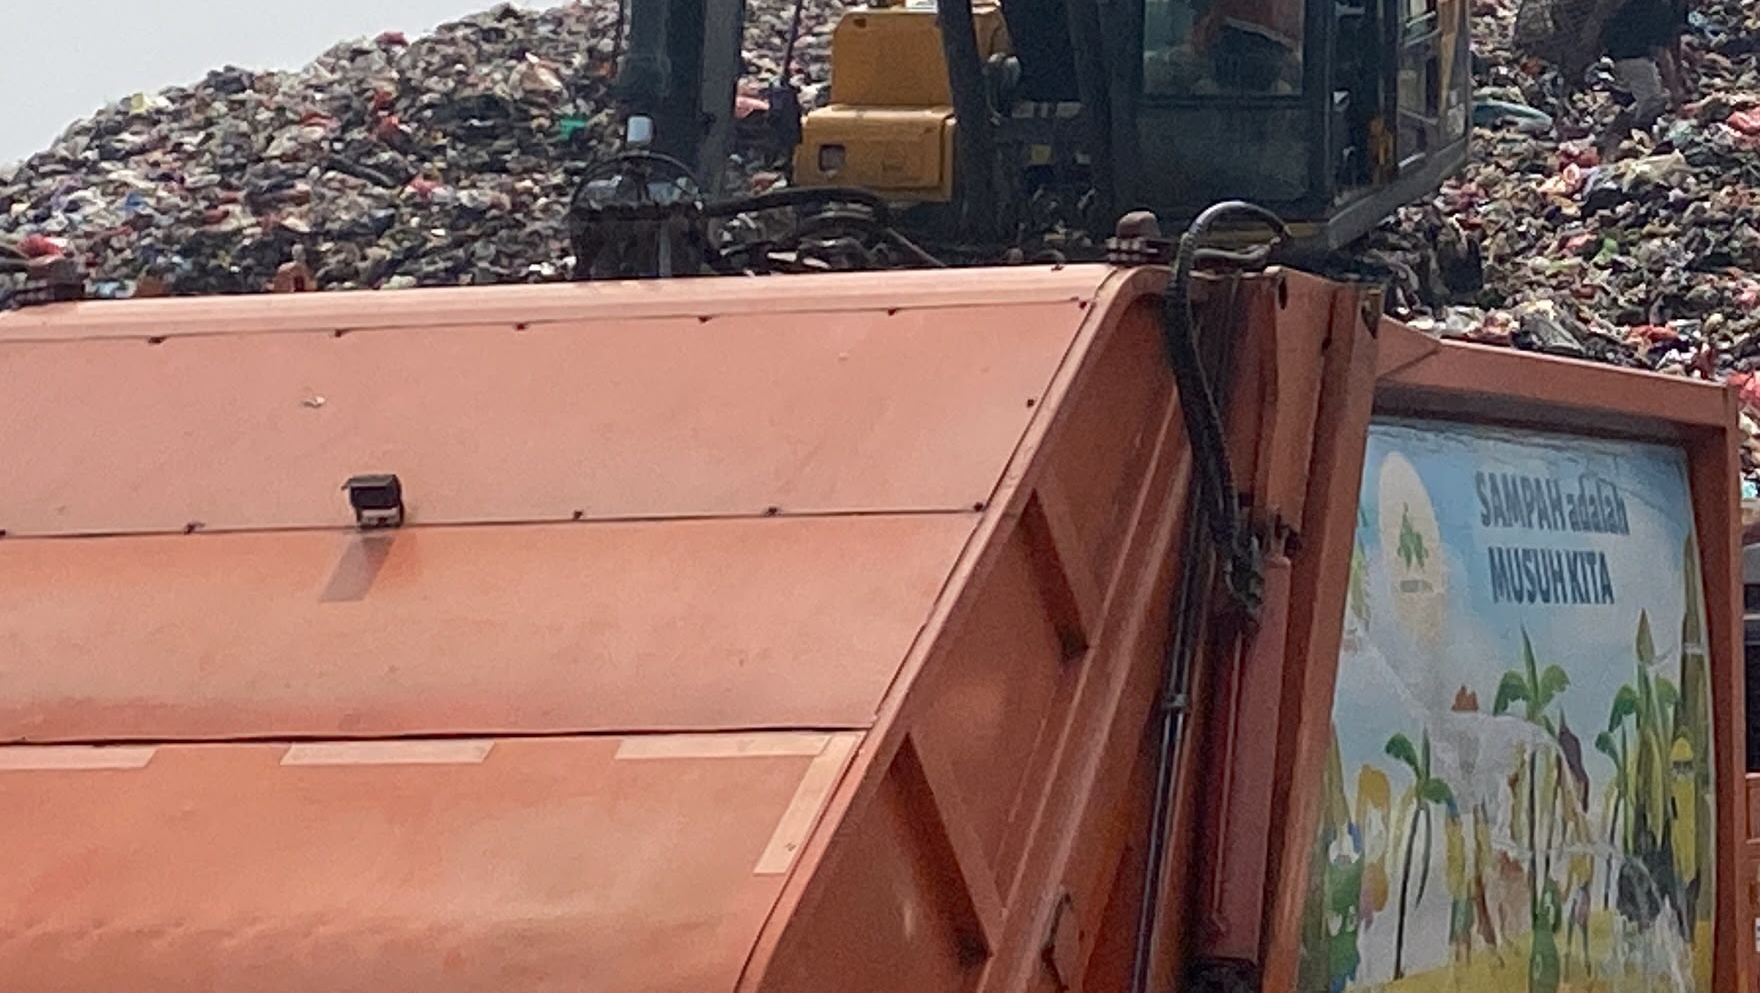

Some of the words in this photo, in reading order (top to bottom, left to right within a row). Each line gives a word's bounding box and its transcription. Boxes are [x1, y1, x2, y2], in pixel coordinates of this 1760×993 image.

[1475, 470, 1566, 531] SAMPAH
[1567, 474, 1630, 535] adalah
[1488, 546, 1567, 605] MUSUH
[1568, 550, 1616, 606] KITA
